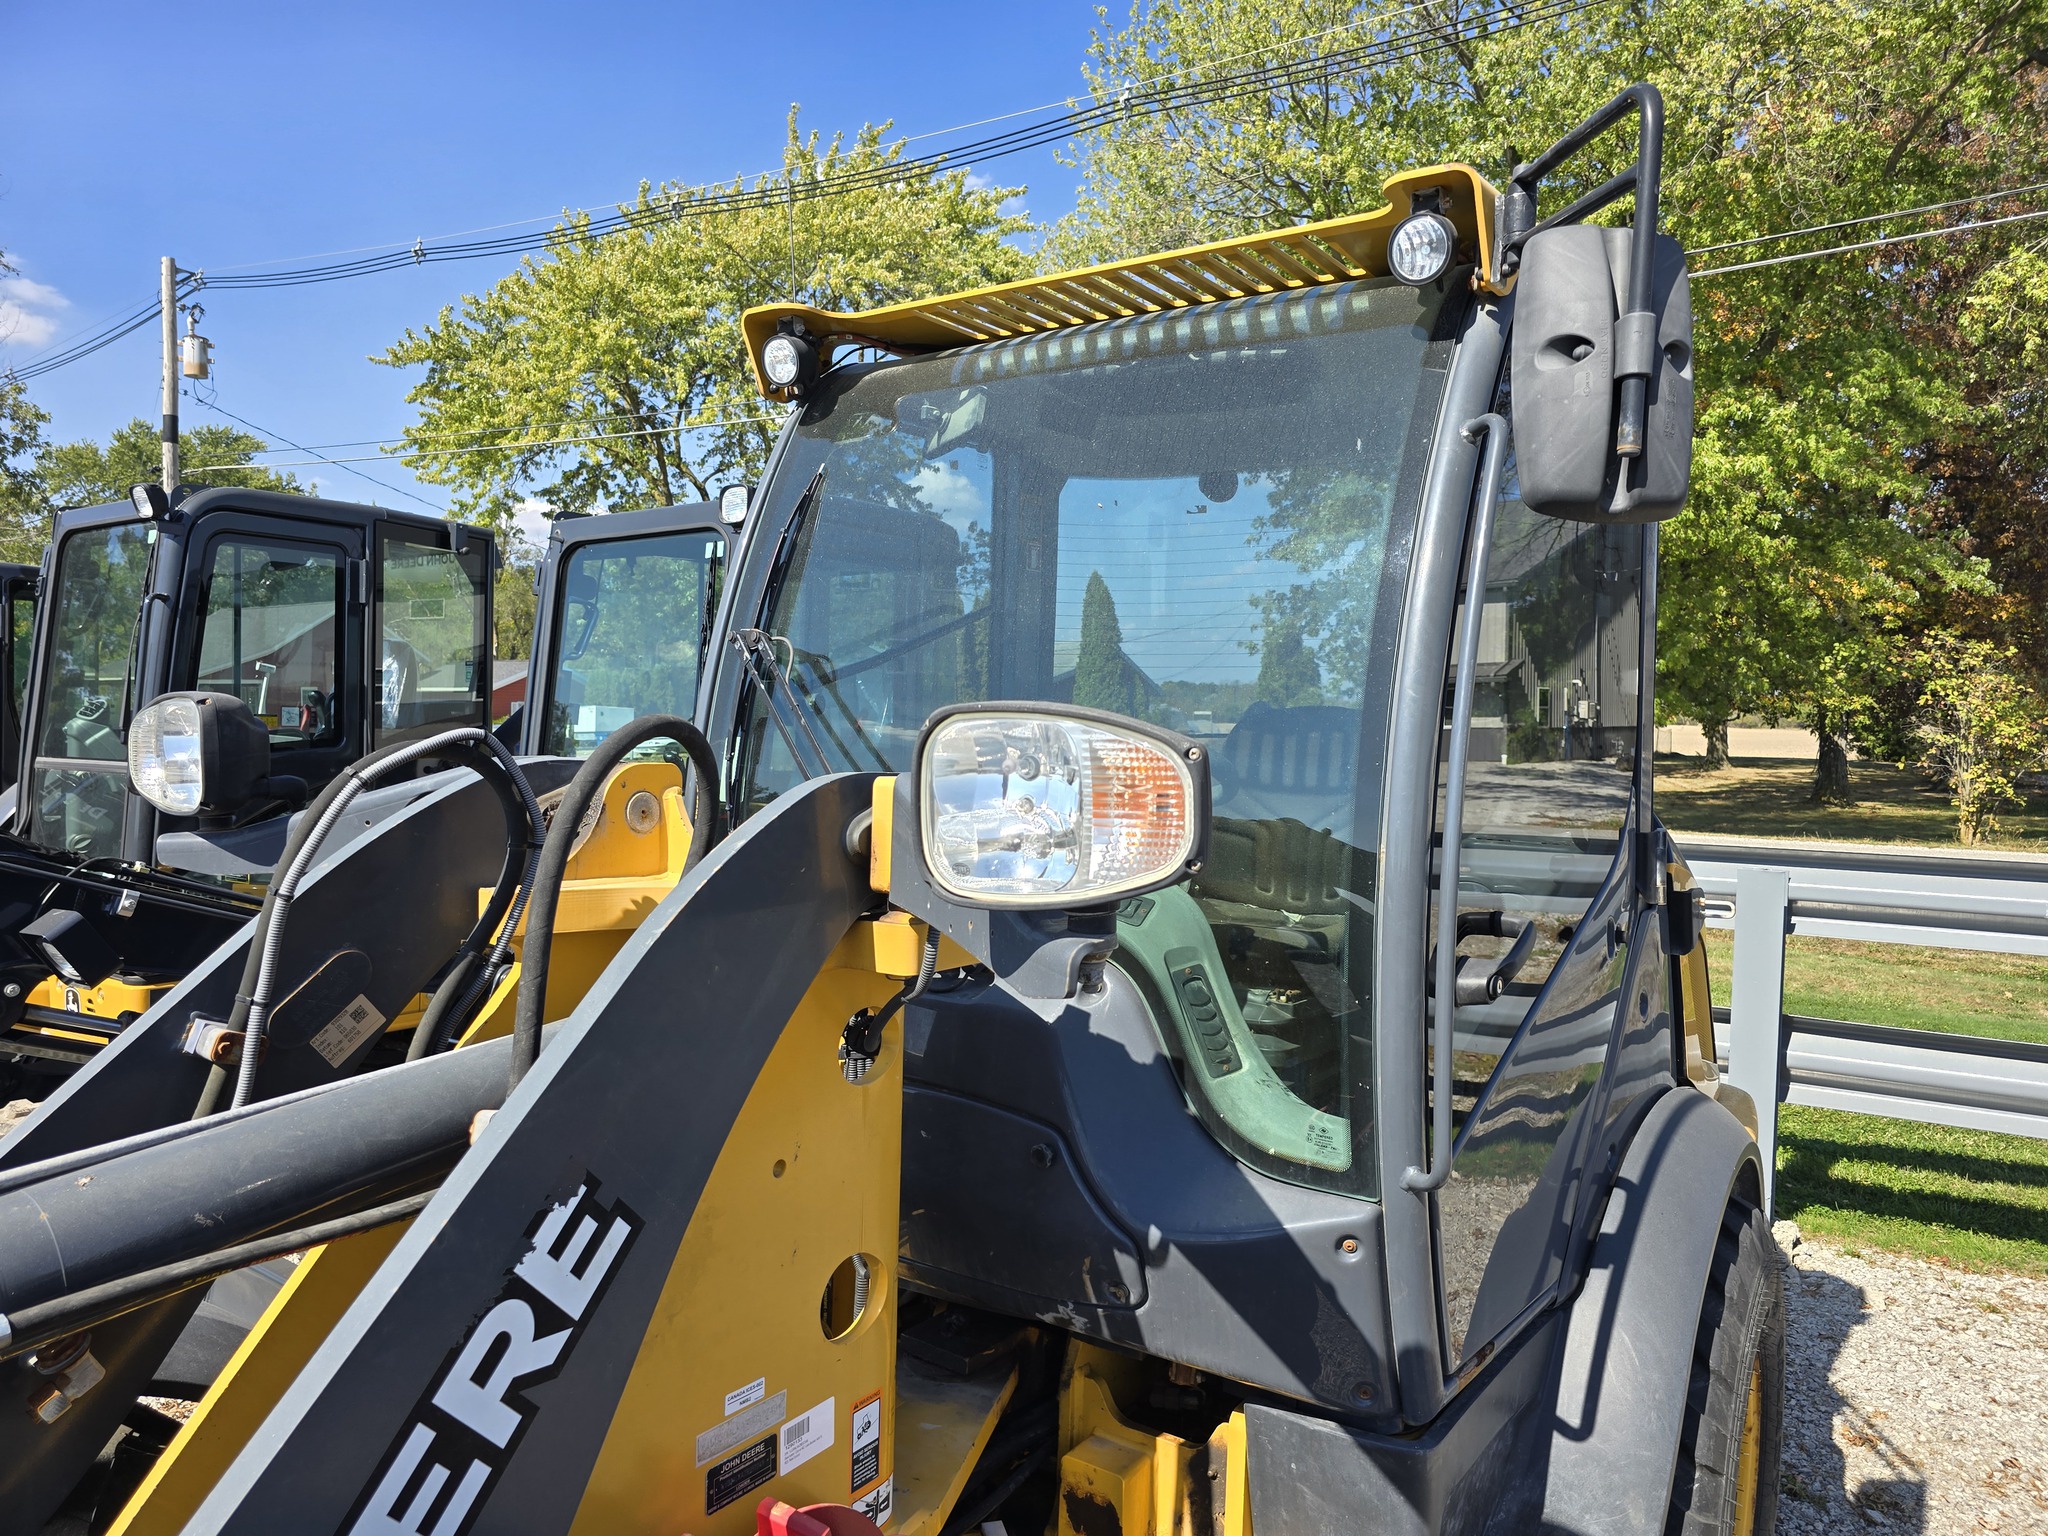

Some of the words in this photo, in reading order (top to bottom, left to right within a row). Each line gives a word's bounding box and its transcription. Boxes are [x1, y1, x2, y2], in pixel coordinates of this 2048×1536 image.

[727, 1389, 746, 1402] CANADA
[859, 1389, 880, 1406] WARNING
[721, 1456, 741, 1474] JOHN
[741, 1442, 766, 1462] DEERE
